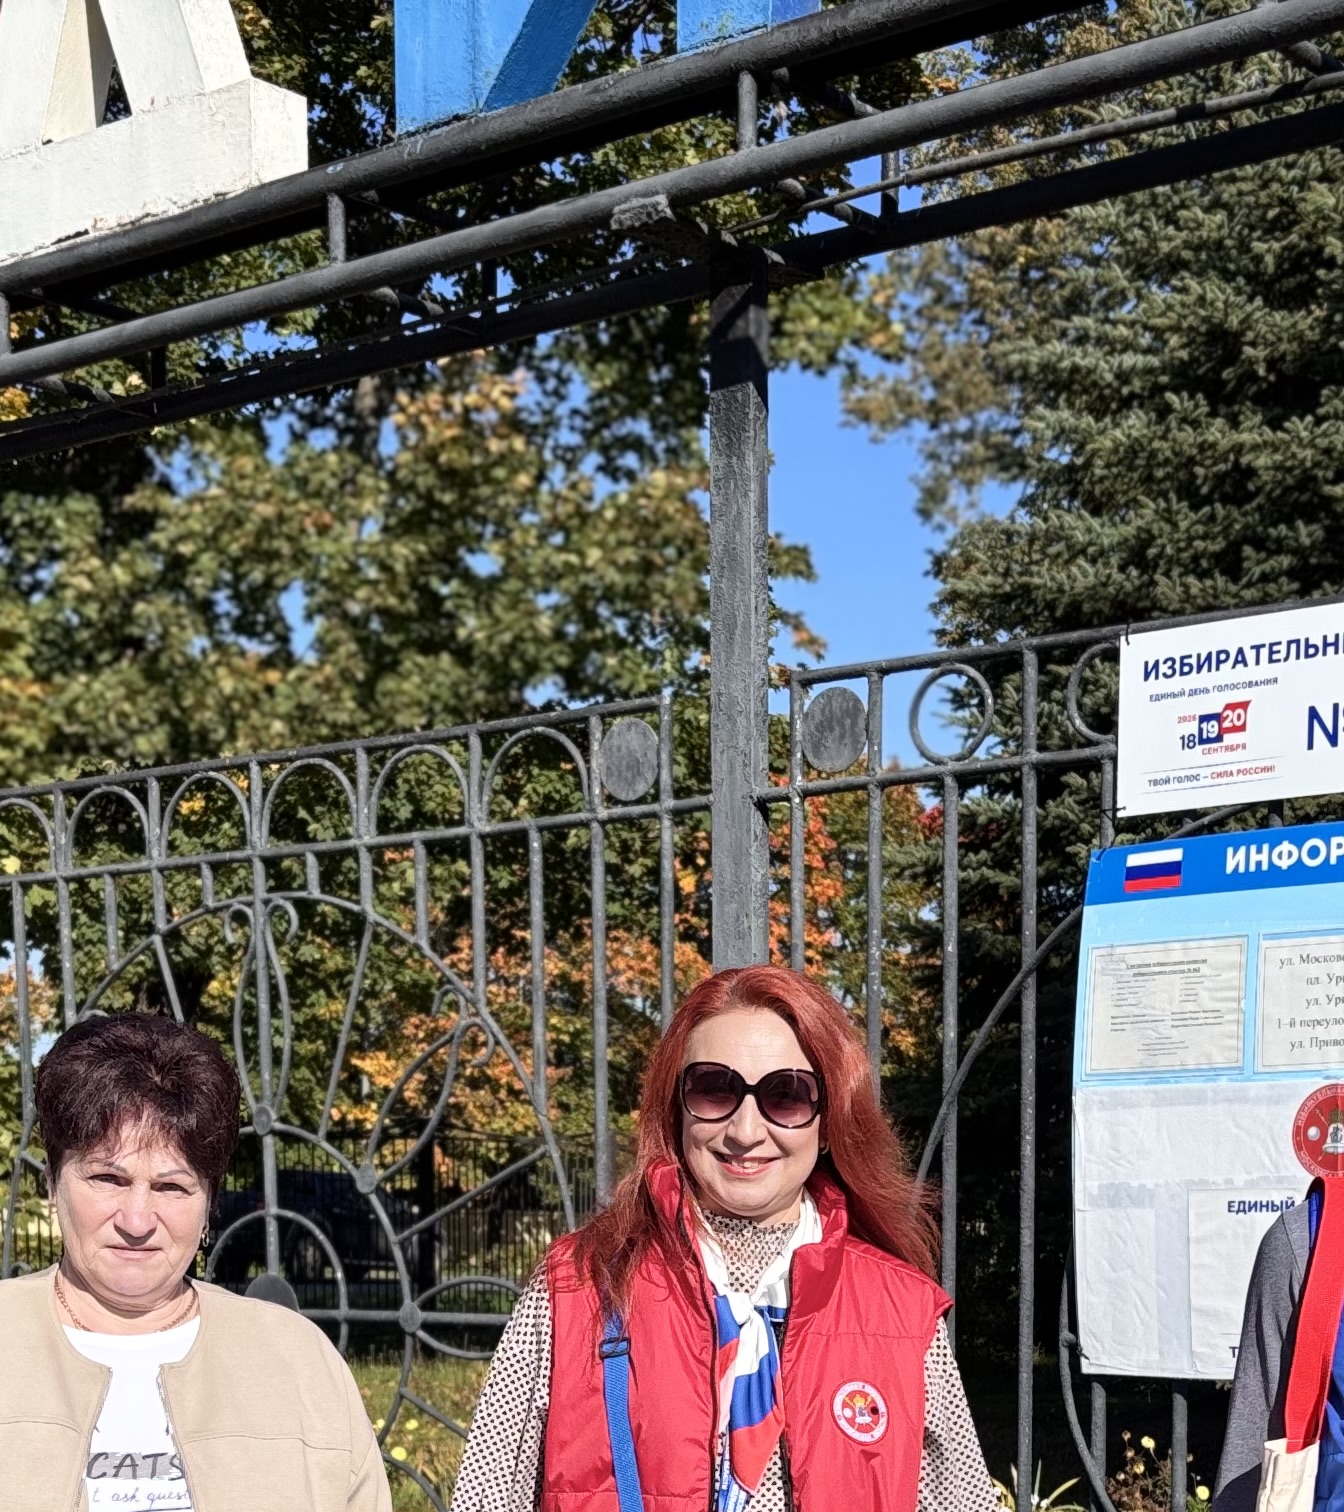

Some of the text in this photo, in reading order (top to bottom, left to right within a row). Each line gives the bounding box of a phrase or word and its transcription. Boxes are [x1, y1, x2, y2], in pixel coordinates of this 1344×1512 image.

[1149, 677, 1279, 703] ЕДИНЫЙ ДЕНЬ ГОЛОСОВАНИЯ
[1179, 708, 1246, 751] 18 19 20
[1201, 743, 1247, 756] СЕНТЯБРЯ
[1148, 775, 1171, 788] ТВОЙ
[1172, 773, 1201, 785] ГОЛОС
[1210, 767, 1234, 780] СИЛА
[1236, 765, 1276, 778] РОССИИ!
[1279, 957, 1295, 970] ул.
[1305, 997, 1322, 1010] ул.
[1289, 1039, 1306, 1052] ул.
[86, 1452, 185, 1482] CATS
[111, 1486, 141, 1503] ask
